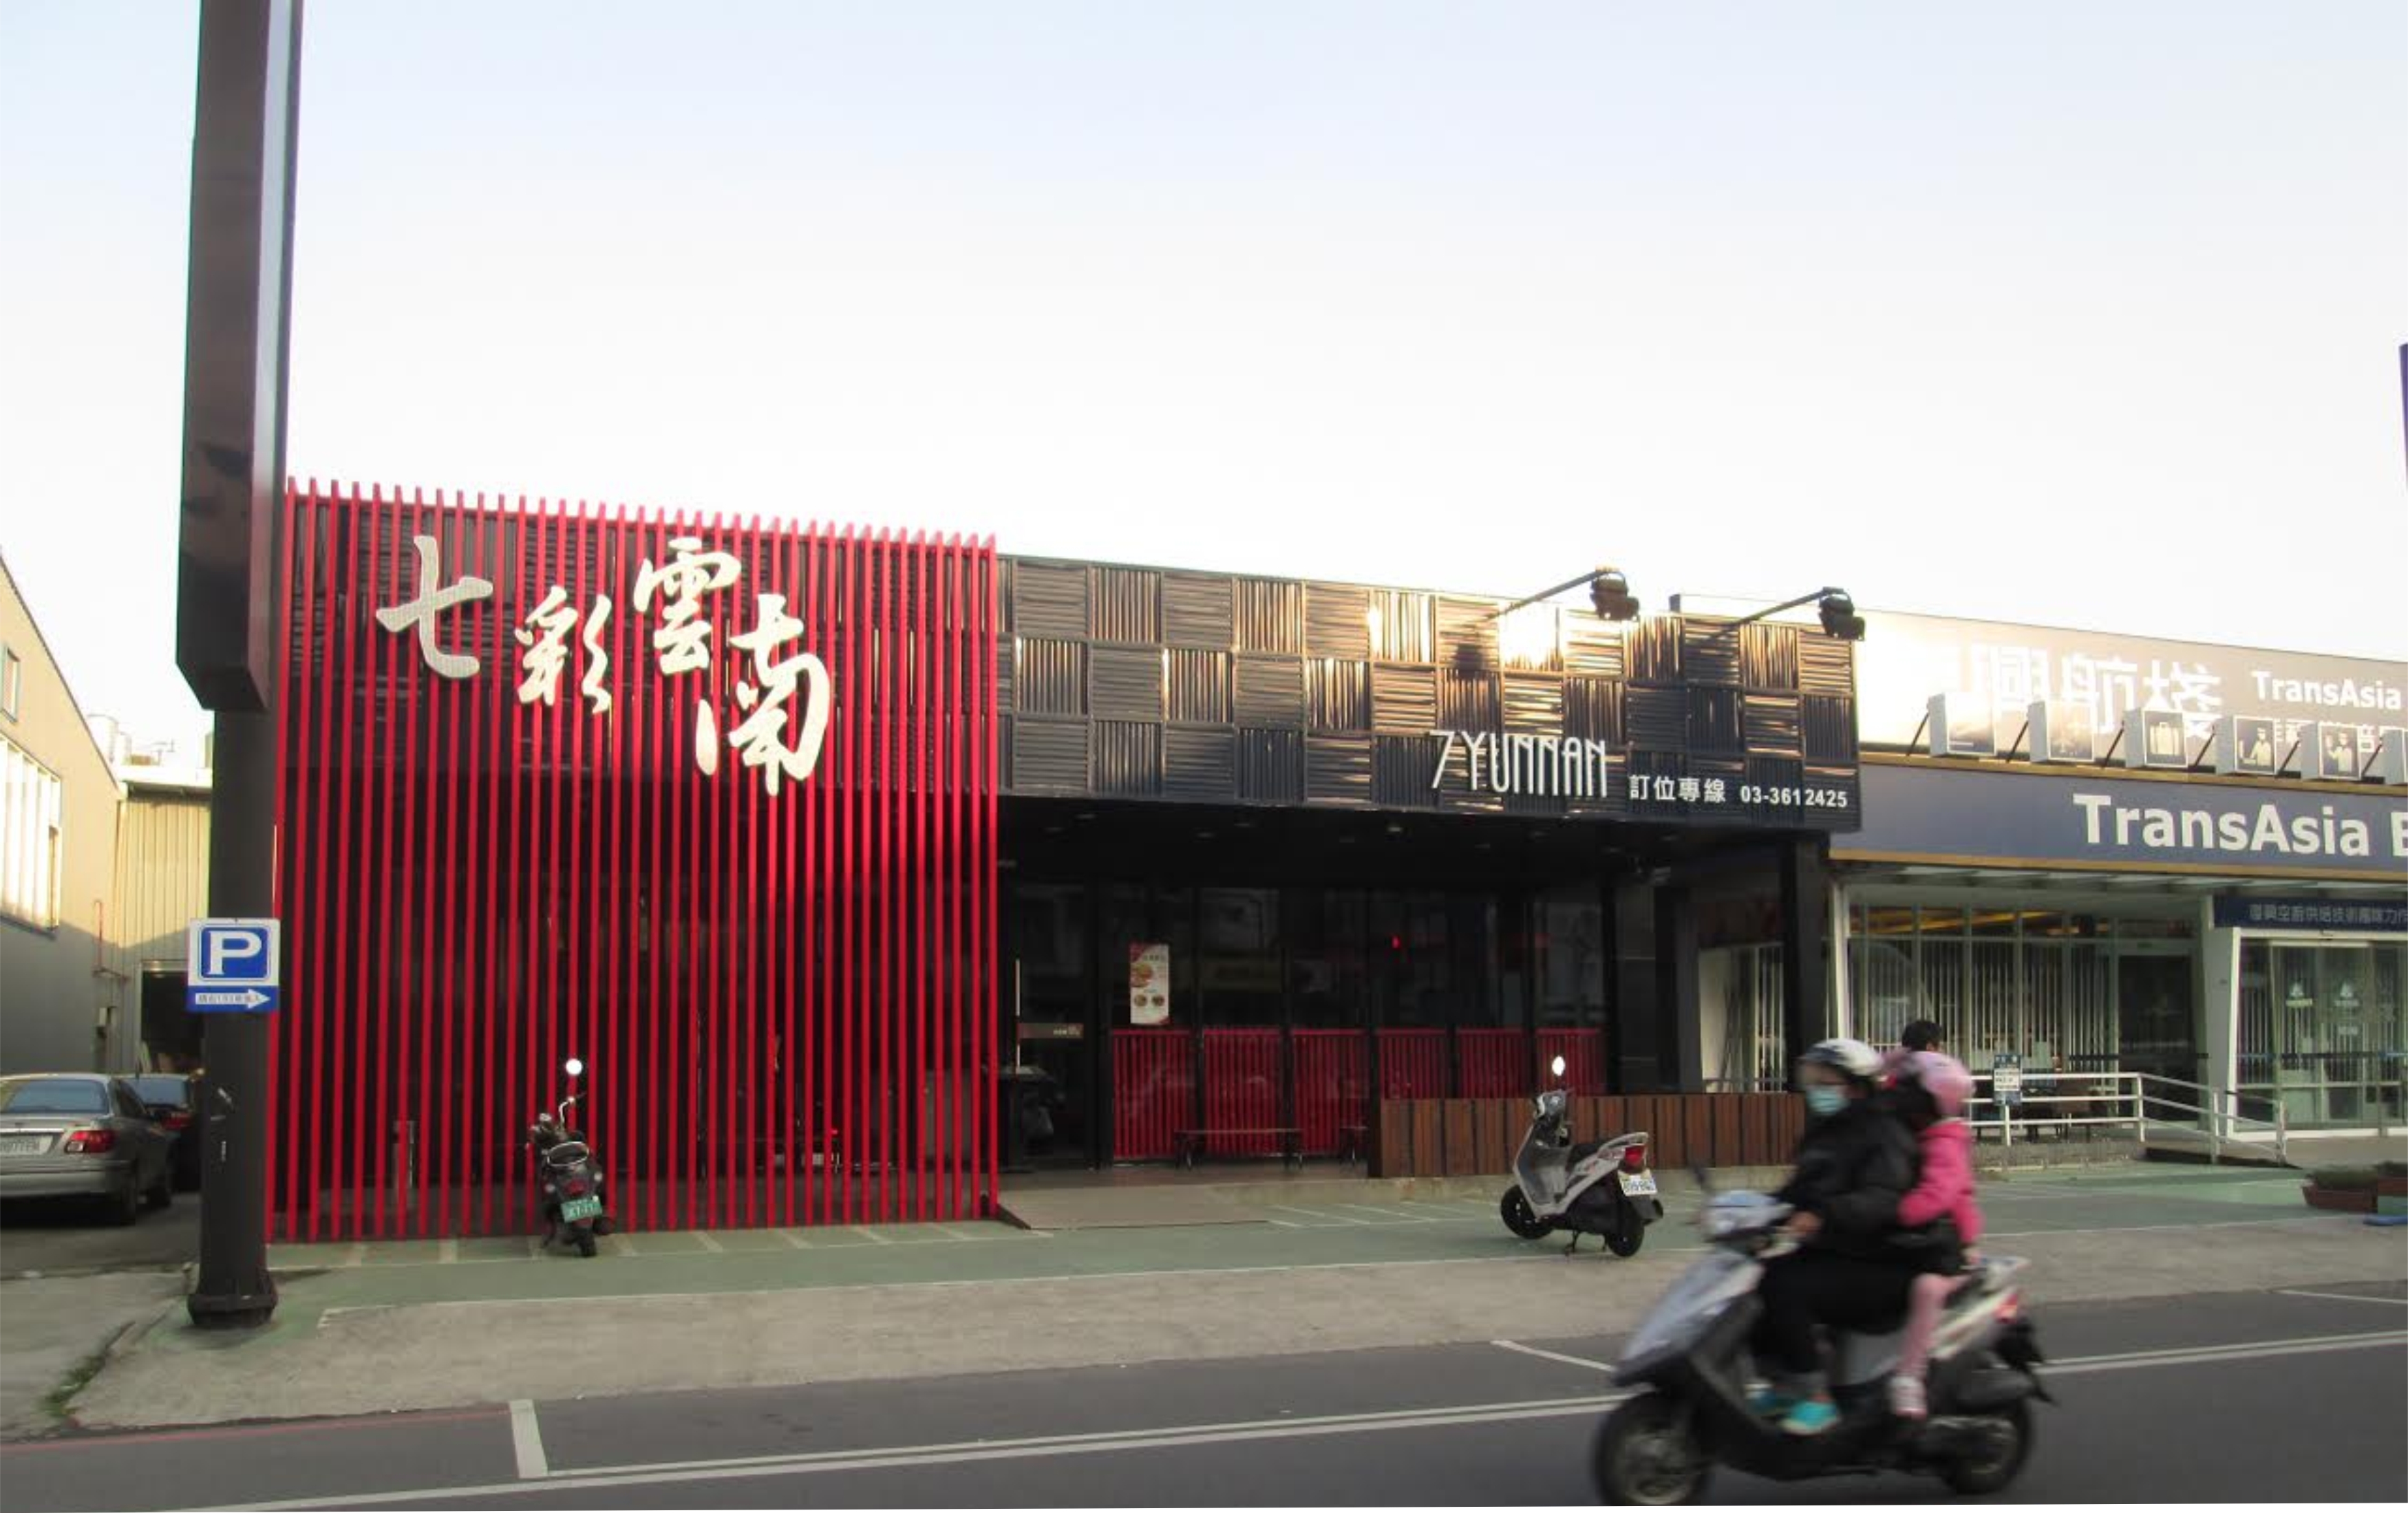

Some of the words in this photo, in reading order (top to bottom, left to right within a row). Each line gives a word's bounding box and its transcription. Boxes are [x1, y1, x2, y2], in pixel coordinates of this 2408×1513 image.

[376, 535, 830, 797] 七彩雲南
[2251, 670, 2402, 710] TransAsia
[1628, 774, 1726, 804] 訂位專線
[1740, 785, 1848, 808] 03-3612425
[2072, 793, 2369, 857] TransAsia
[207, 930, 262, 975] P
